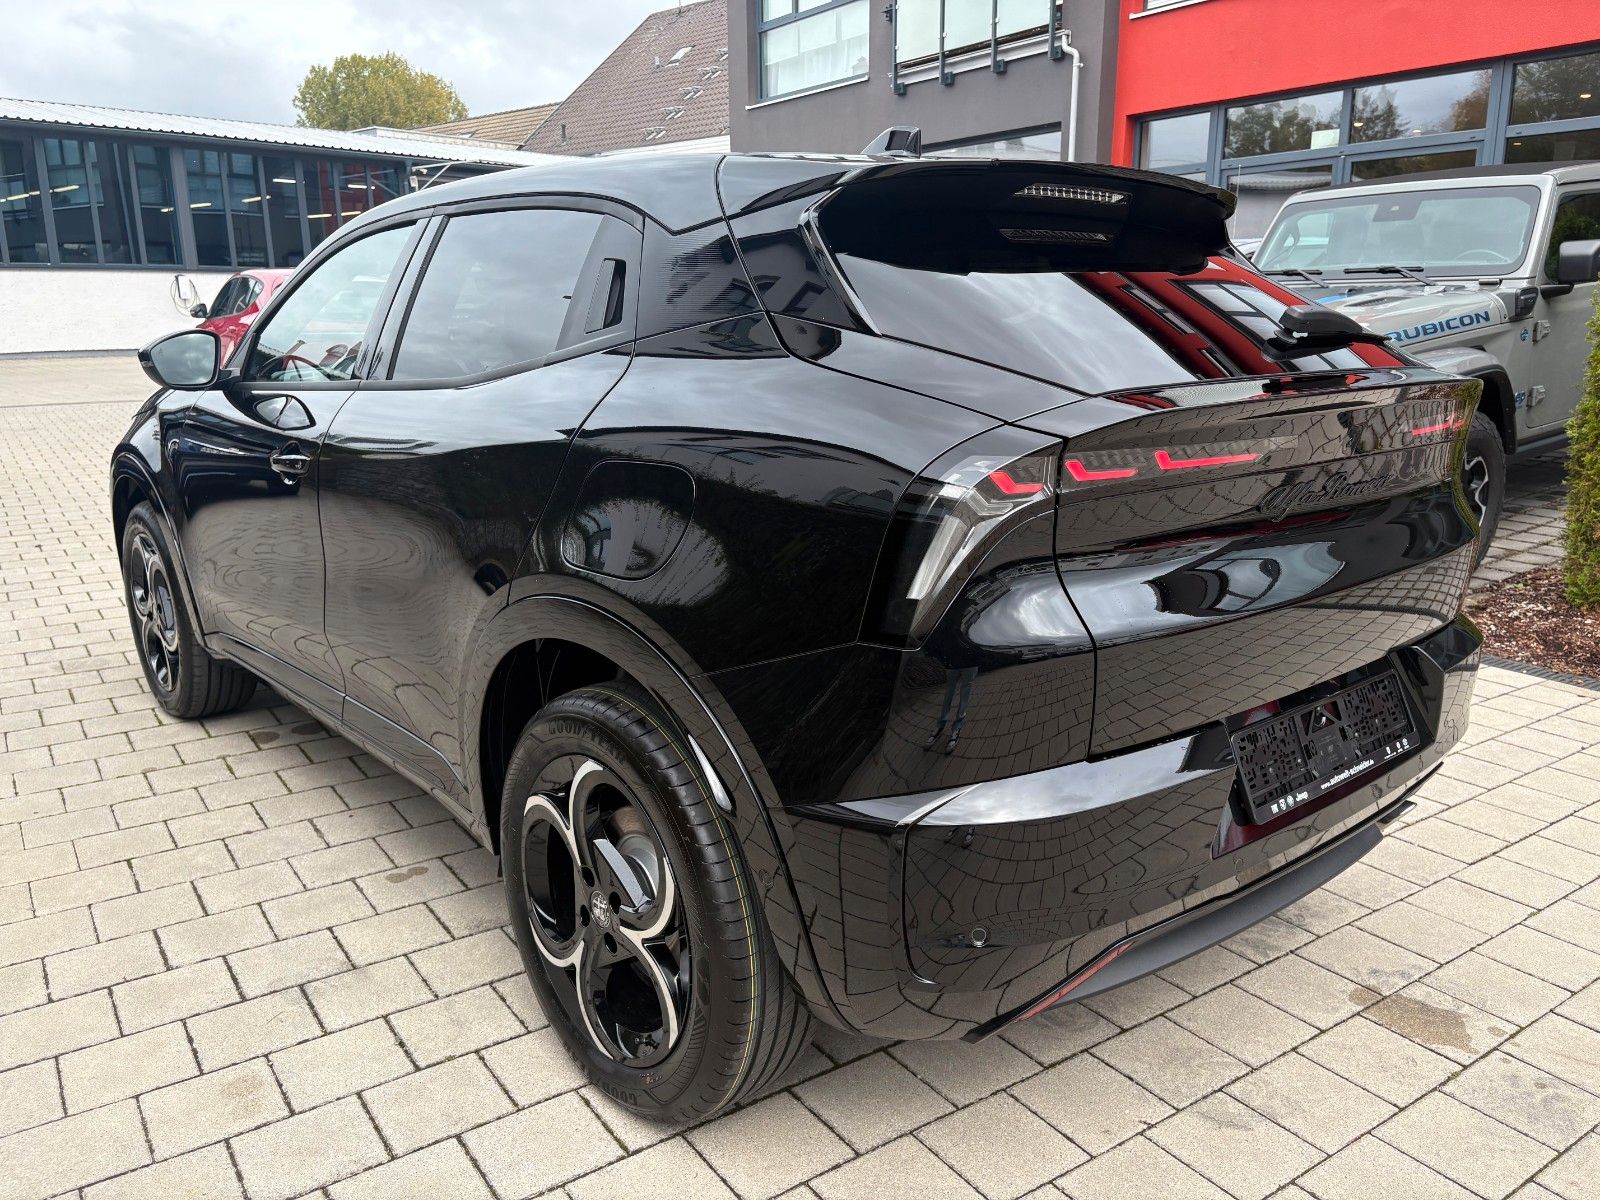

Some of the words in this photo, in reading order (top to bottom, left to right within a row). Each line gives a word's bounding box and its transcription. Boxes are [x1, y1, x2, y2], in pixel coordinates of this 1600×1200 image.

[1384, 311, 1490, 342] RUBICON
[1259, 480, 1322, 522] Alfa
[1322, 471, 1391, 500] Romeo
[1295, 791, 1309, 802] Jeep
